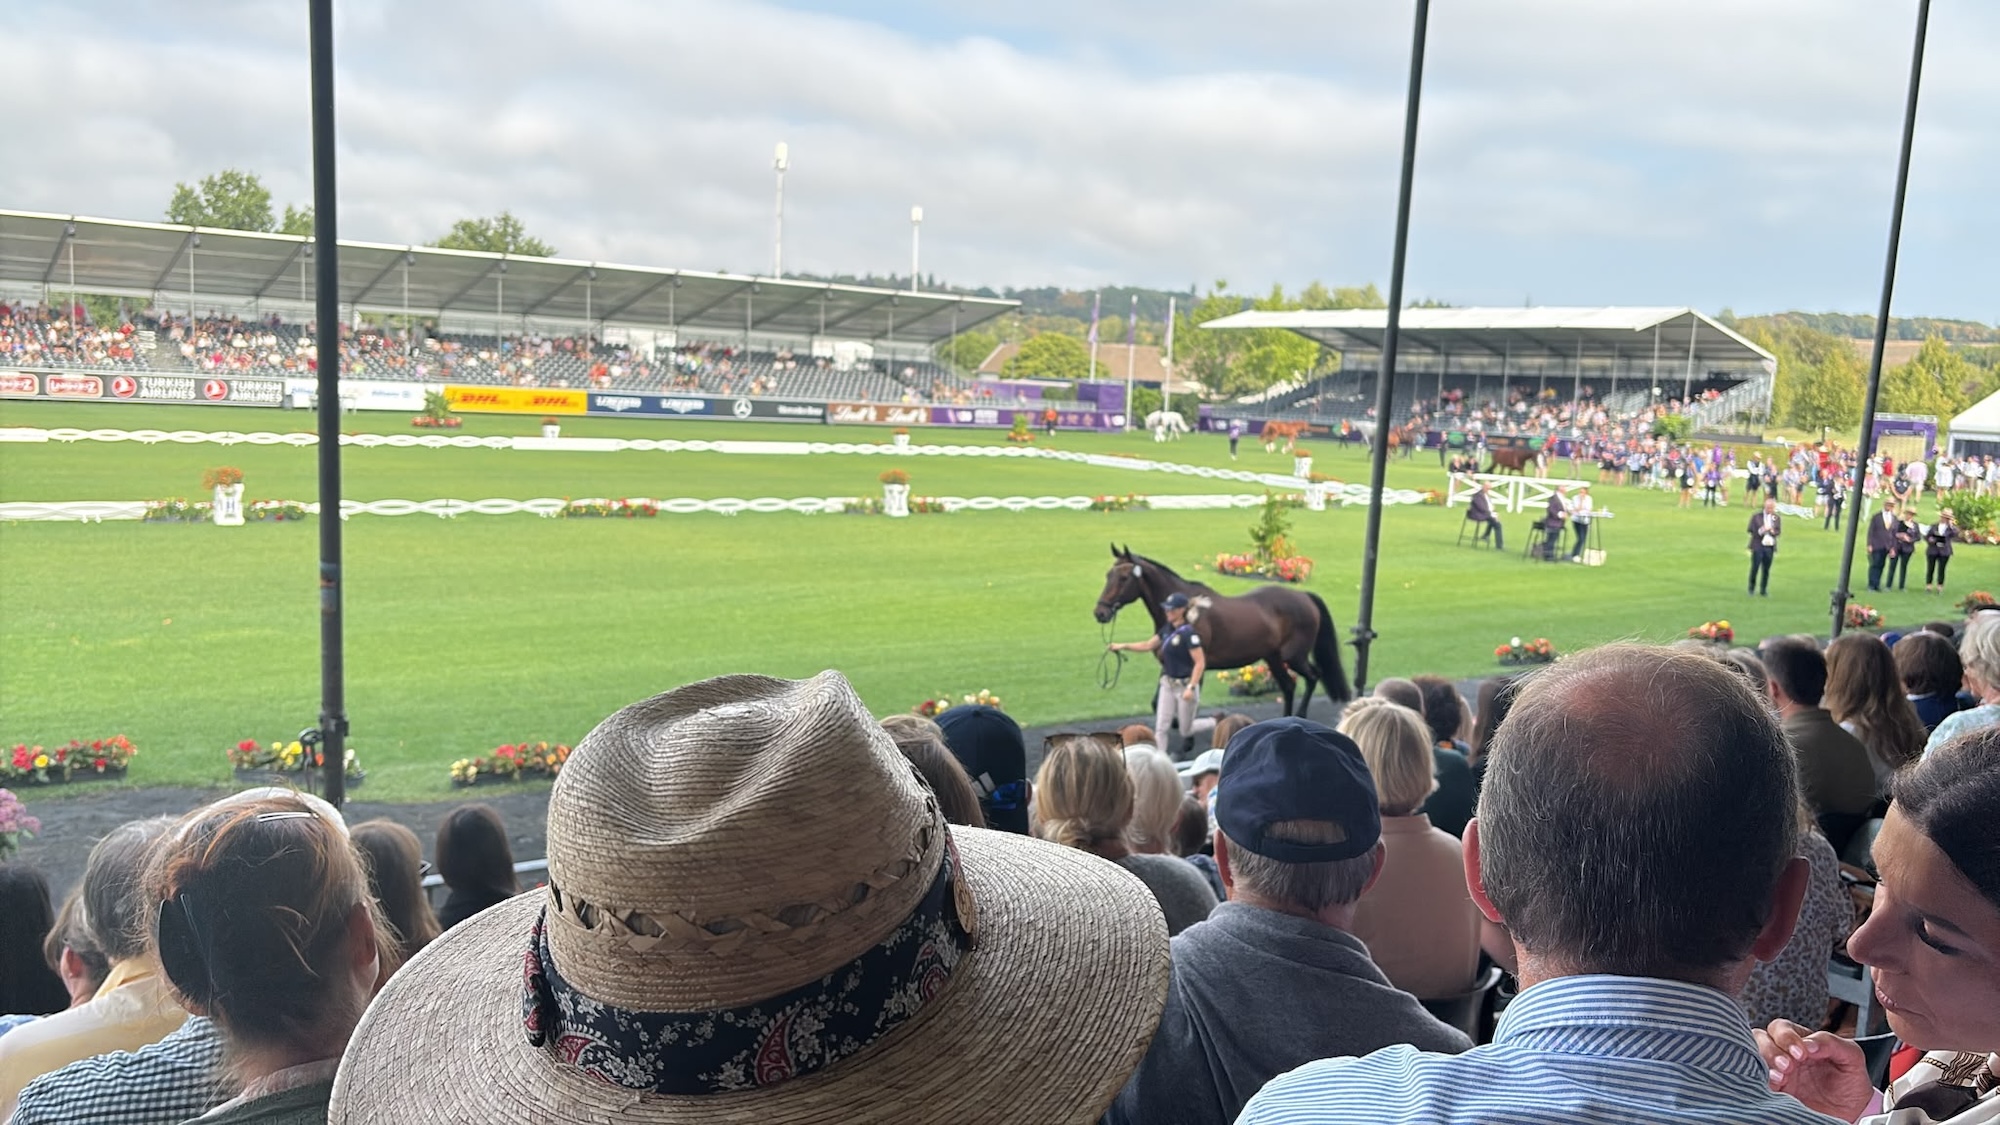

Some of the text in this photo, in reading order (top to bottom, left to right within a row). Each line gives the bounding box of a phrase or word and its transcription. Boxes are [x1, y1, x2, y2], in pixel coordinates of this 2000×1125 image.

[140, 377, 195, 389] TURKISH
[230, 380, 282, 392] TURKISH
[140, 387, 196, 400] AIRLINES
[230, 390, 283, 403] AIRLINES
[461, 393, 499, 403] DHL
[532, 396, 569, 405] DHL
